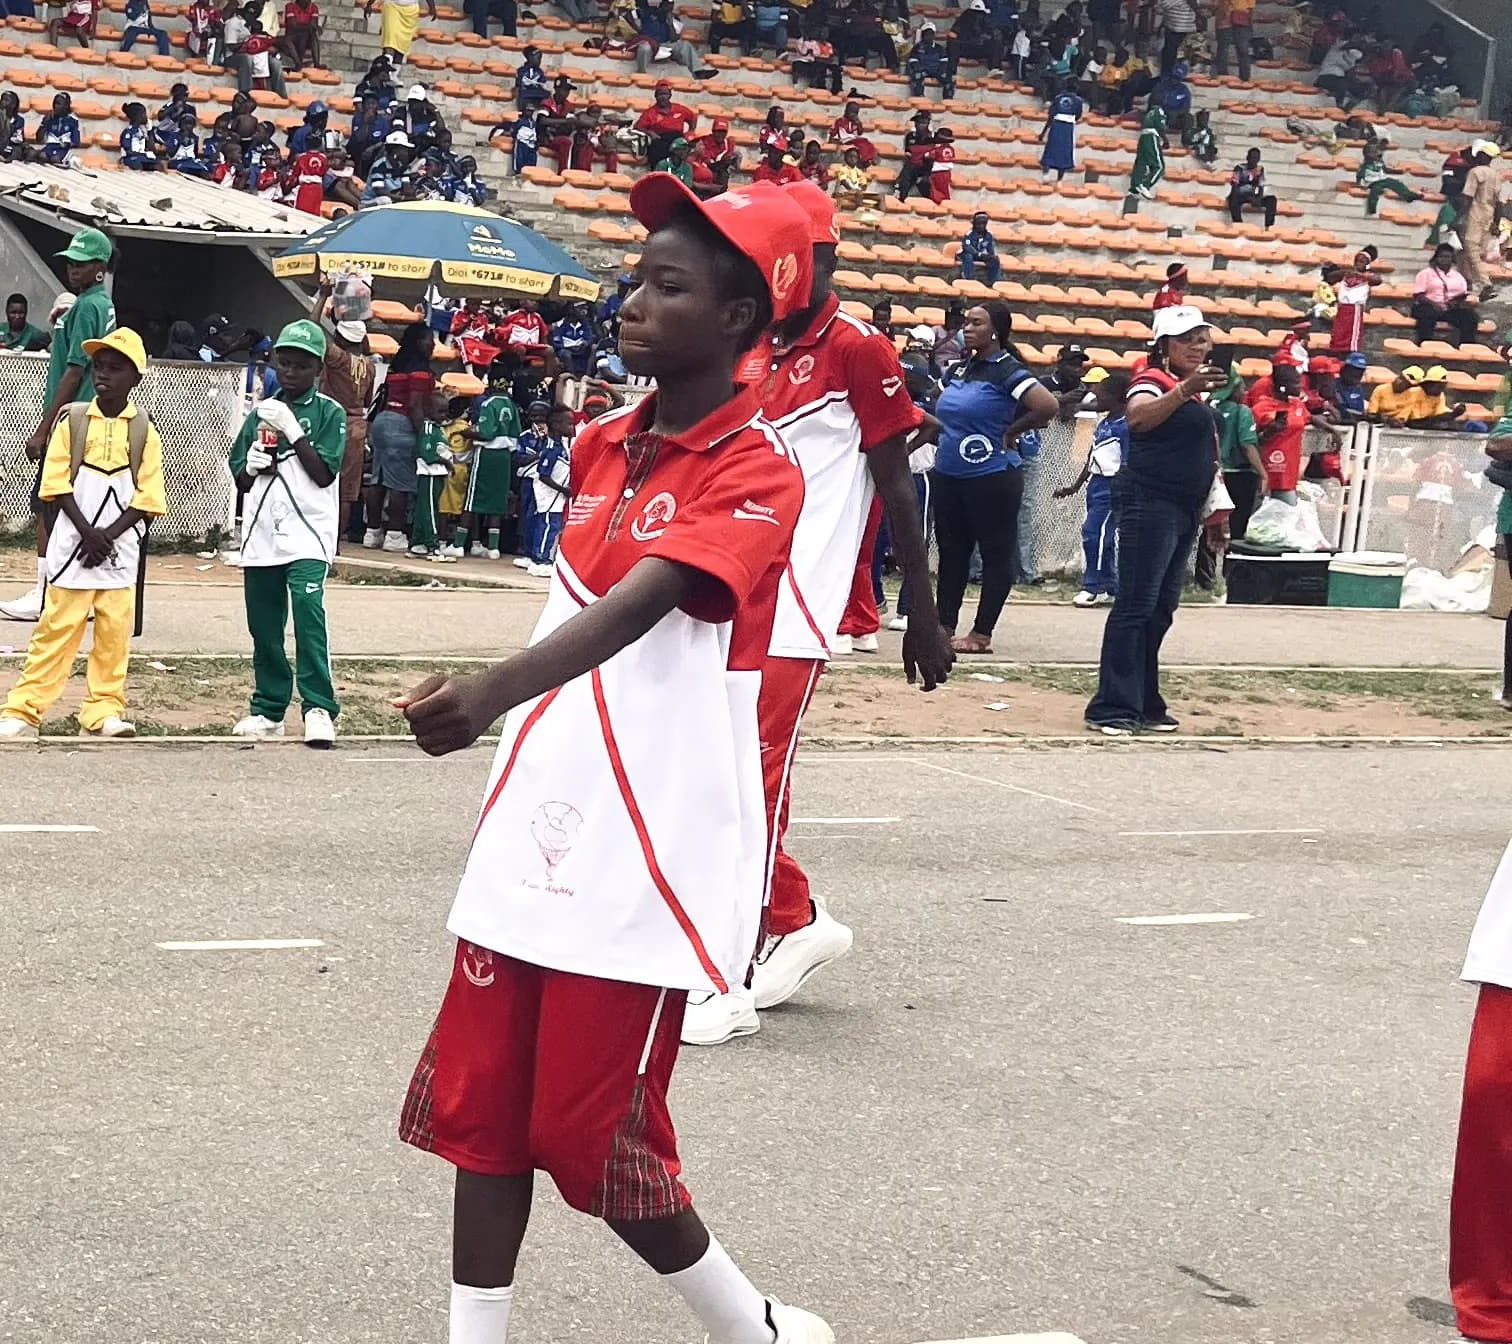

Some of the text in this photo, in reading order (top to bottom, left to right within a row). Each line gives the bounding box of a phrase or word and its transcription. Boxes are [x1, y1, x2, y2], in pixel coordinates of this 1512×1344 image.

[467, 242, 516, 258] MoMo
[388, 263, 398, 271] to
[401, 263, 427, 273] start
[448, 267, 468, 278] Dial
[505, 274, 517, 283] to
[519, 277, 545, 288] start
